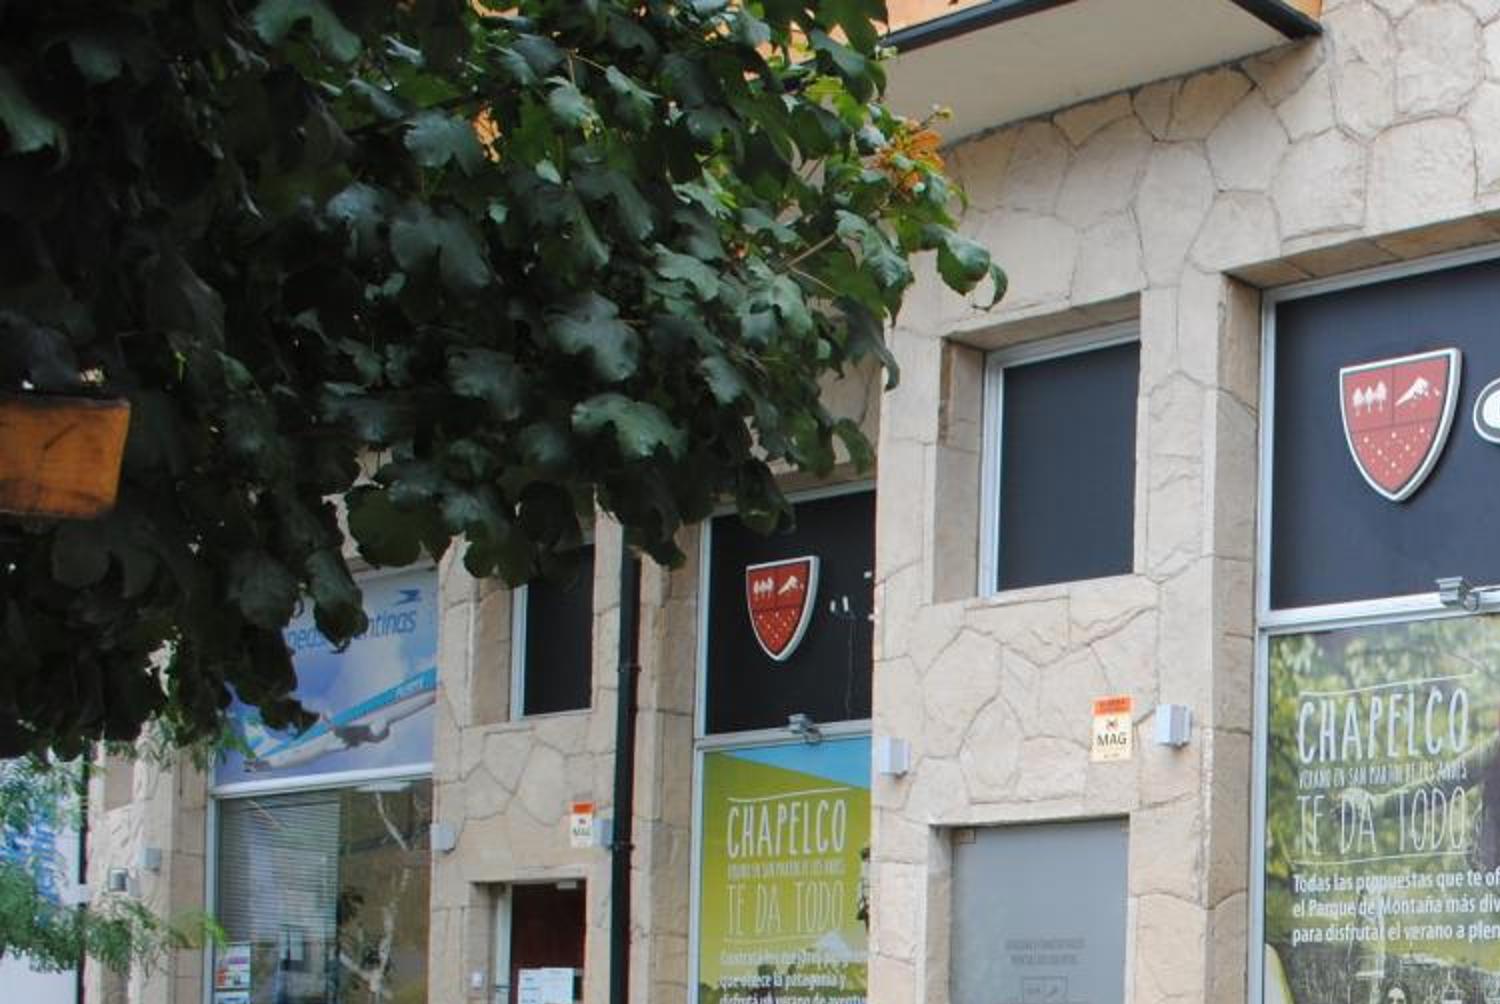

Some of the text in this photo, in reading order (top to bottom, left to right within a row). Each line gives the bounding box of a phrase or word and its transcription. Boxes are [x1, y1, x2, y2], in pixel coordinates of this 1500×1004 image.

[1299, 686, 1470, 764] CHAPELCO
[727, 799, 848, 858] CHAPELCO
[1297, 786, 1465, 856] TE DA TODO
[726, 880, 844, 936] TE DA TODO
[1294, 874, 1331, 893] Todas
[1334, 873, 1353, 891] las
[1356, 872, 1434, 895] propuestas
[1436, 872, 1464, 892] que
[1467, 868, 1483, 886] te
[1294, 901, 1305, 917] el
[1308, 899, 1356, 921] Parque
[1358, 899, 1375, 916] de
[1380, 895, 1442, 915] Montaña
[1446, 892, 1475, 912] más
[1293, 928, 1323, 946] para
[1388, 921, 1400, 940] el
[1405, 925, 1453, 940] verano
[1456, 924, 1465, 939] a
